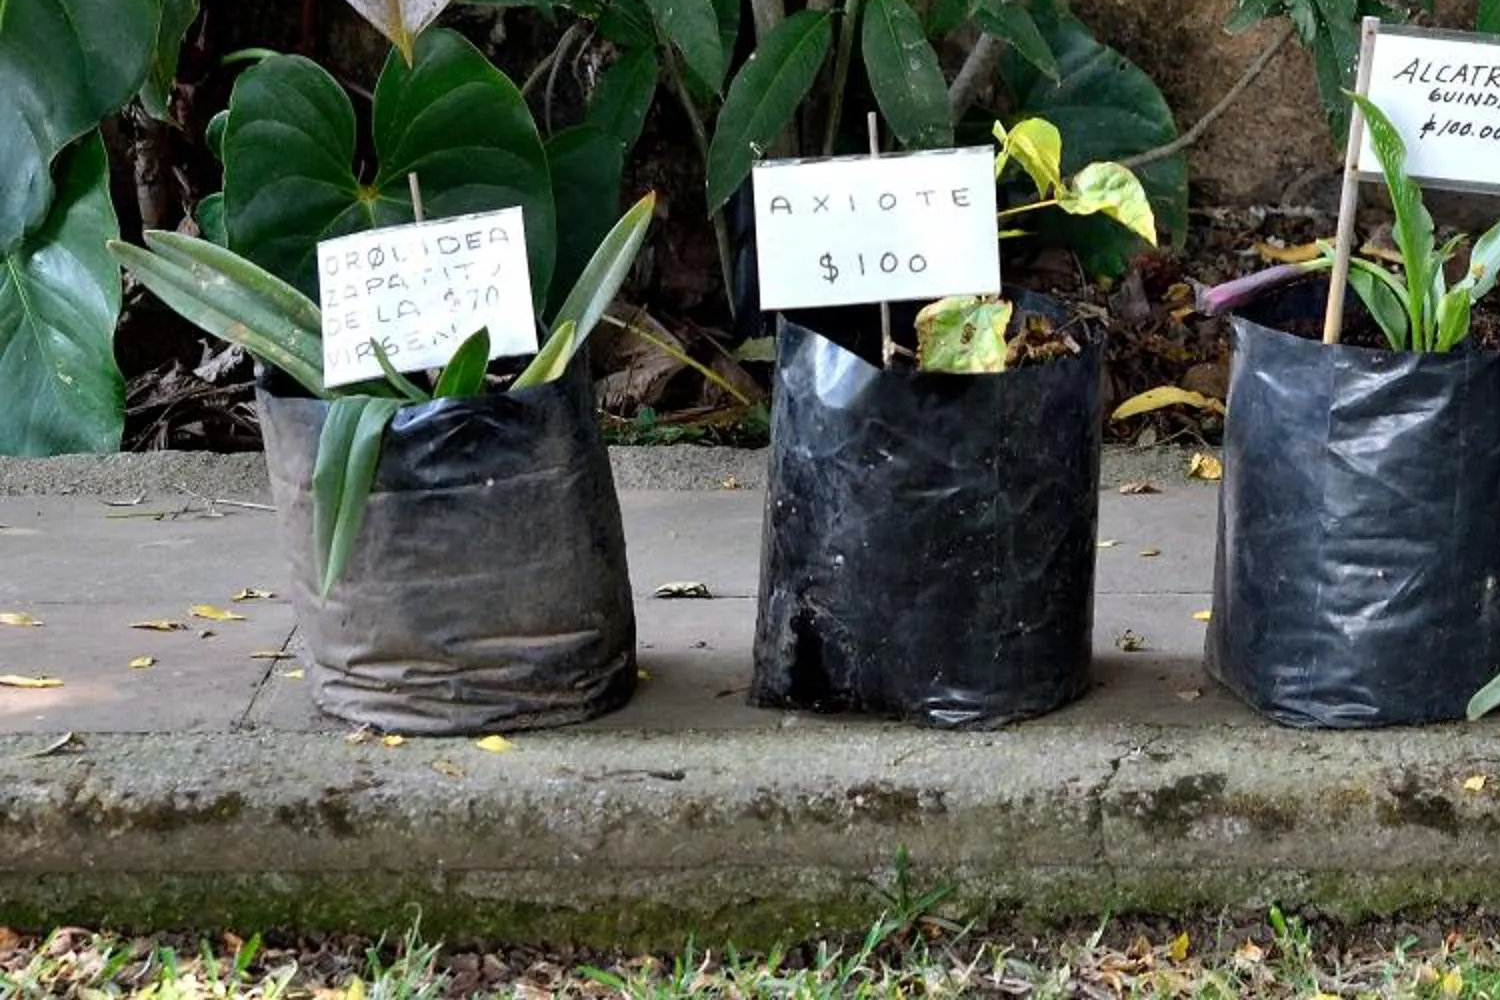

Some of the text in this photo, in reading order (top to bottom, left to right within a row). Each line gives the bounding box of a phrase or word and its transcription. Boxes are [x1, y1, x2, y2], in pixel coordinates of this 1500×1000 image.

[769, 187, 972, 215] AXIOTE
[819, 251, 928, 285] $100
[326, 311, 361, 337] DE
[376, 299, 421, 323] LA
